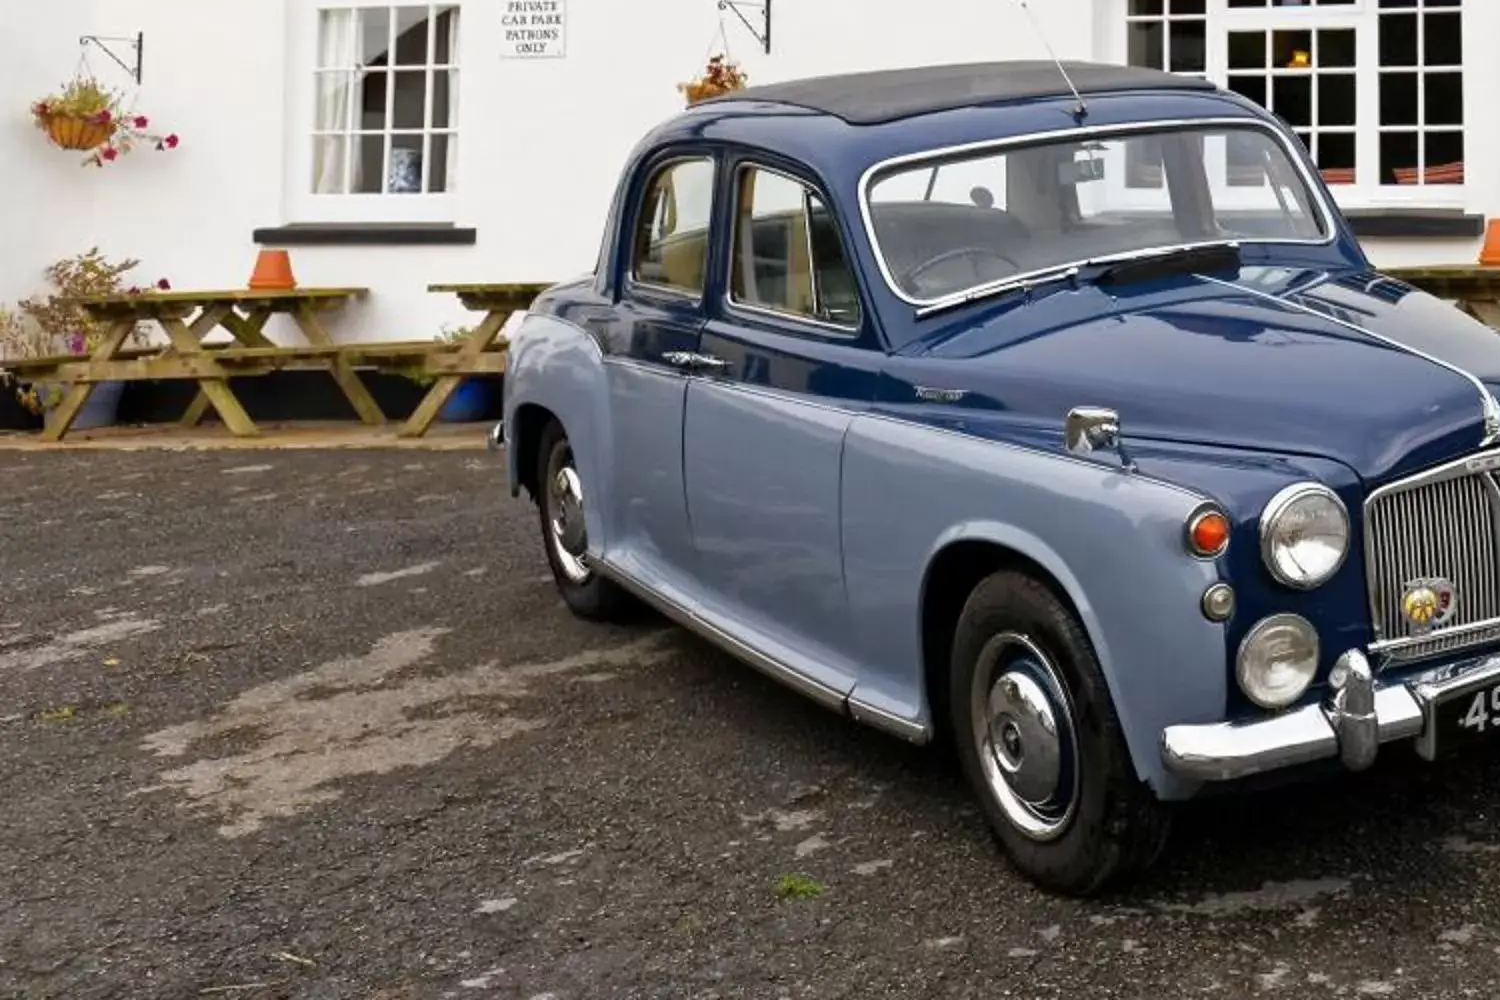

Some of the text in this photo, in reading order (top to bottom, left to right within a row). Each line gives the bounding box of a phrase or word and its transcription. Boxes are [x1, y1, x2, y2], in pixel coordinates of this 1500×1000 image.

[507, 0, 558, 12] PRIVATE
[501, 13, 562, 26] CAR PARK
[505, 29, 560, 41] PATRONS
[515, 42, 548, 53] ONLY
